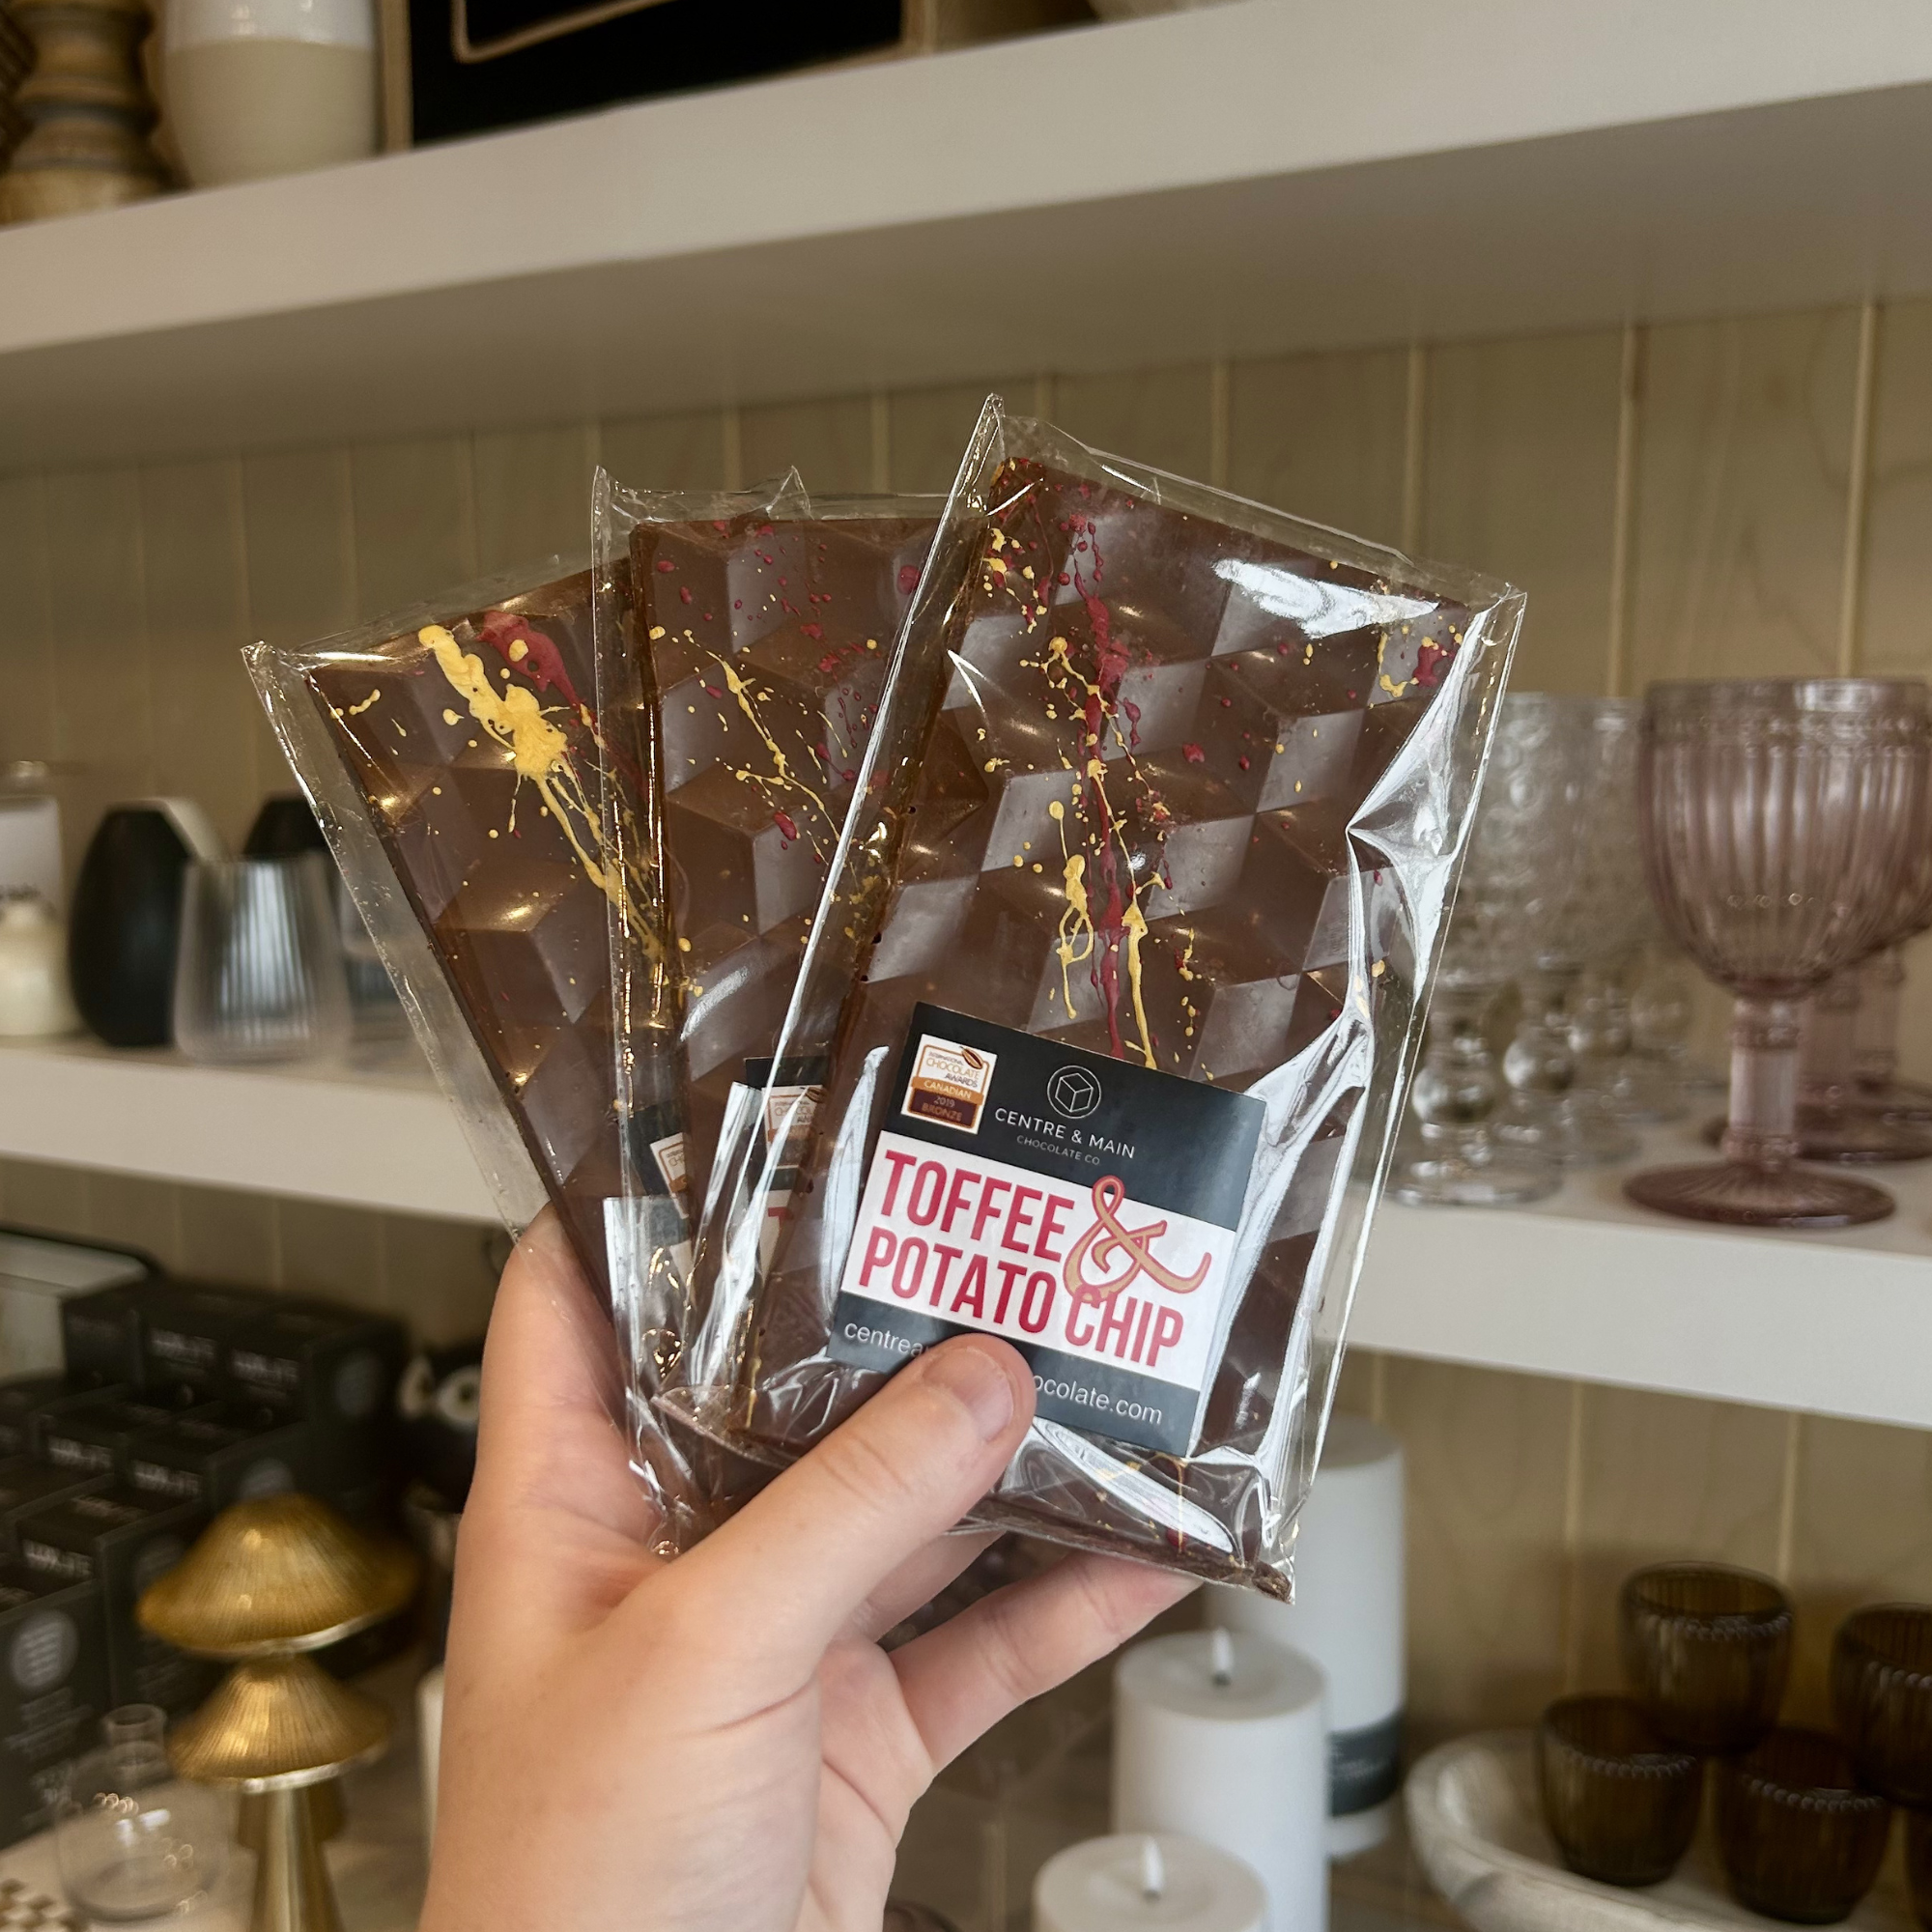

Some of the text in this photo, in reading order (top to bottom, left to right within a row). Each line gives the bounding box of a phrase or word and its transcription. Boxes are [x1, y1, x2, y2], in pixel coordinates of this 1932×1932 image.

[926, 1058, 980, 1080] CHOCOLATE
[923, 1080, 972, 1099] CANADIAN
[945, 1073, 978, 1088] AWARDS
[922, 1102, 963, 1122] BRONZE
[934, 1095, 955, 1108] 2019
[995, 1108, 1135, 1159] CENTRE & MAIN
[1016, 1135, 1082, 1160] CHOCOLATE
[880, 1150, 1211, 1301] TOFFEE &
[859, 1227, 1184, 1368] POTATO CHIP
